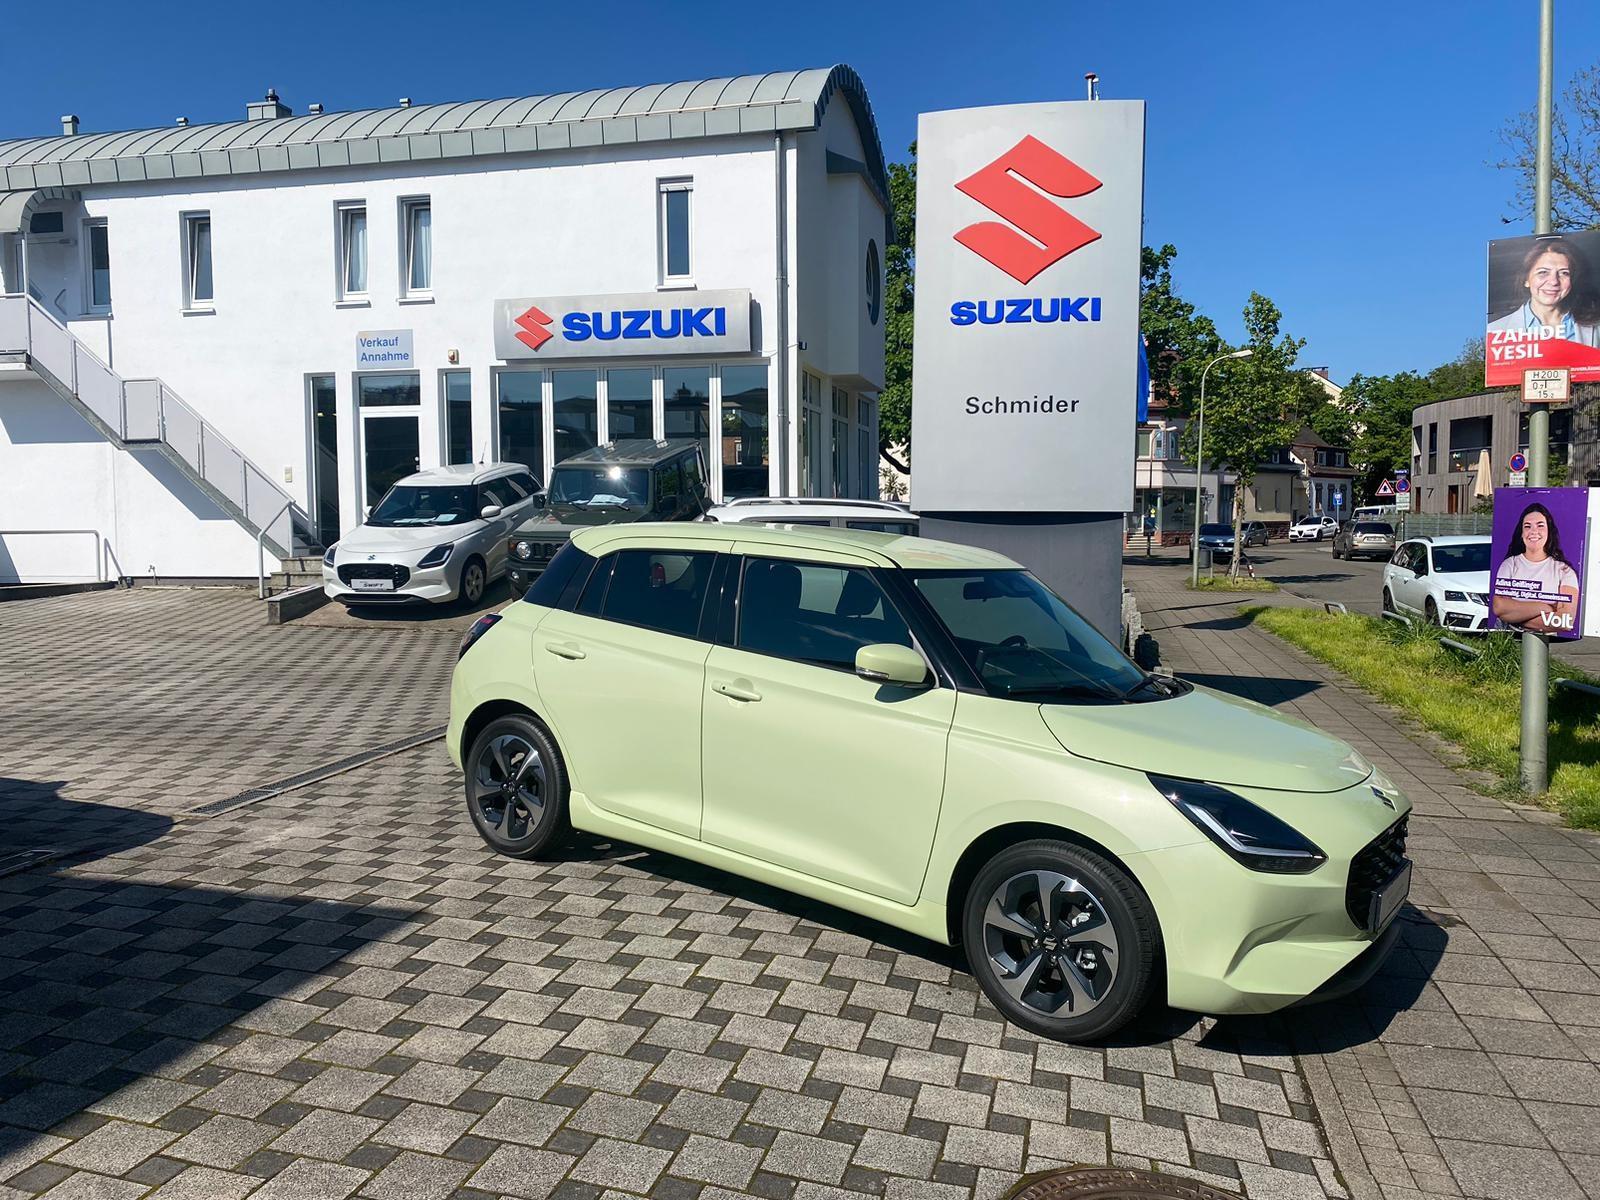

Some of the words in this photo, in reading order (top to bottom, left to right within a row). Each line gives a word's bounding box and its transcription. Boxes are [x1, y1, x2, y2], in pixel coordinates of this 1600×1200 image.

[950, 297, 1101, 325] SUZUKI
[562, 307, 726, 342] SUZUKI
[360, 336, 399, 347] Verkauf
[1491, 325, 1566, 344] ZAHIDE
[360, 351, 409, 362] Annahme
[1491, 343, 1543, 360] YESIL
[965, 395, 1080, 415] Schmider
[1427, 488, 1434, 498] 7
[1540, 610, 1574, 629] Volt
